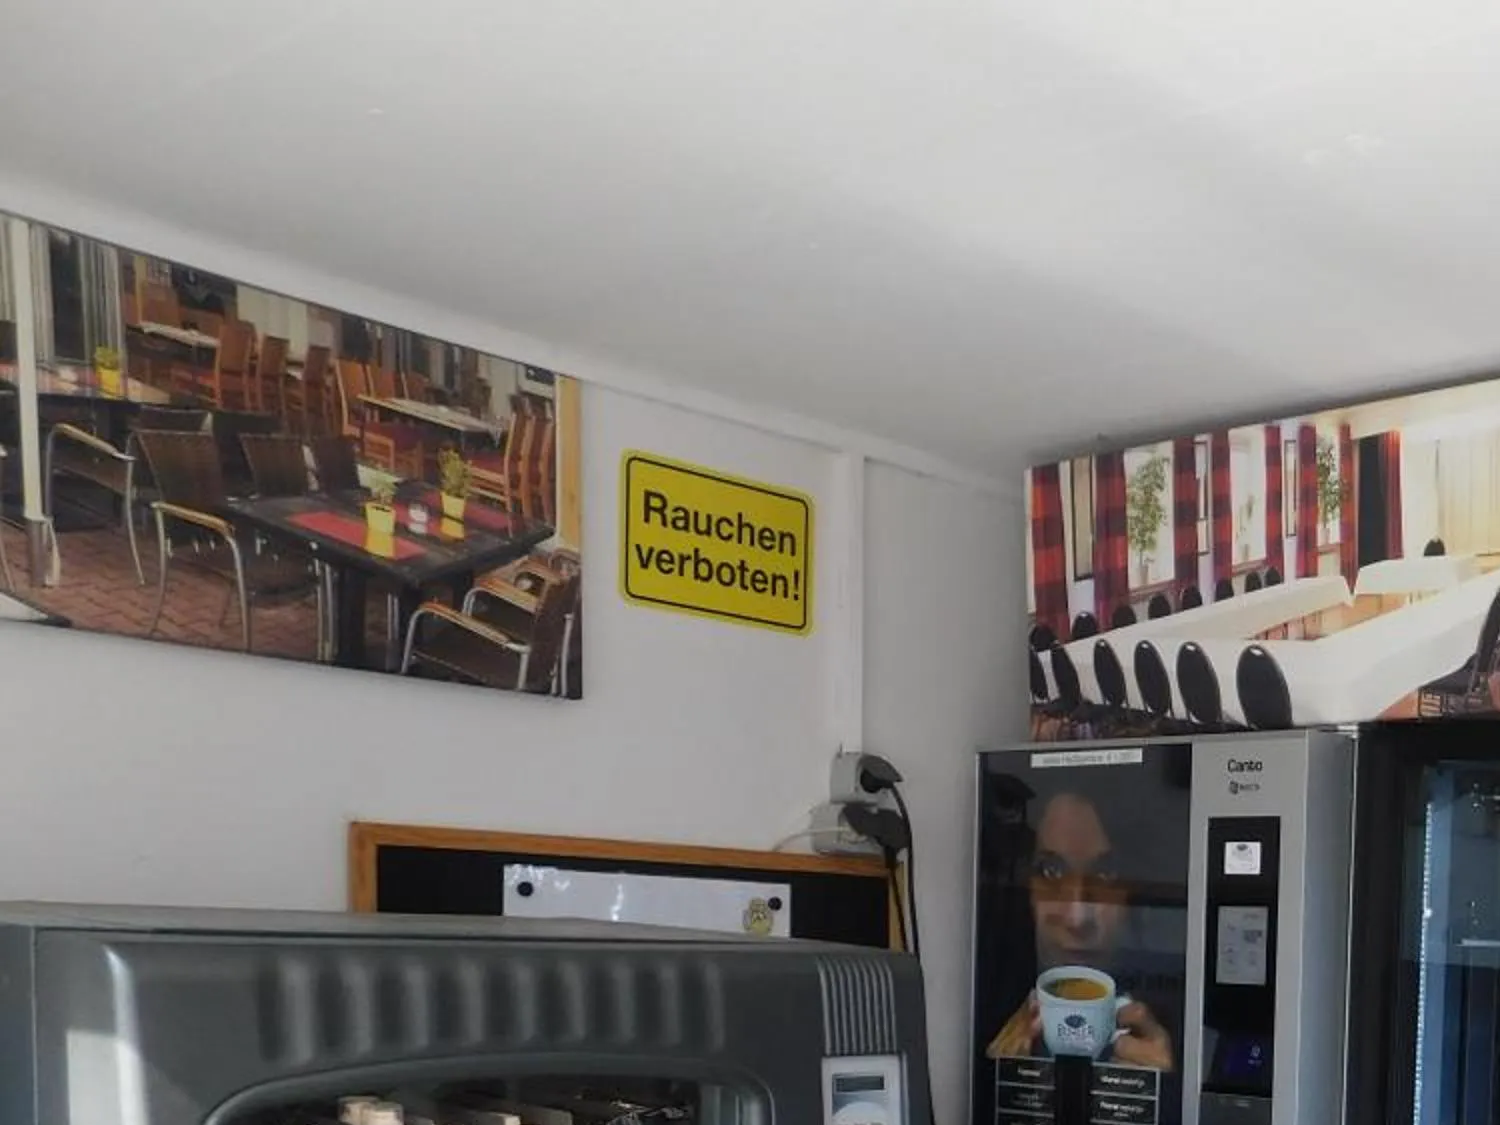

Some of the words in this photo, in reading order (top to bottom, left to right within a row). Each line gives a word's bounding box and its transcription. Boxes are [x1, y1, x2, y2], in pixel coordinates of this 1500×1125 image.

[643, 489, 797, 557] Rauchen
[635, 543, 799, 601] verboten!
[1227, 758, 1264, 774] Canto
